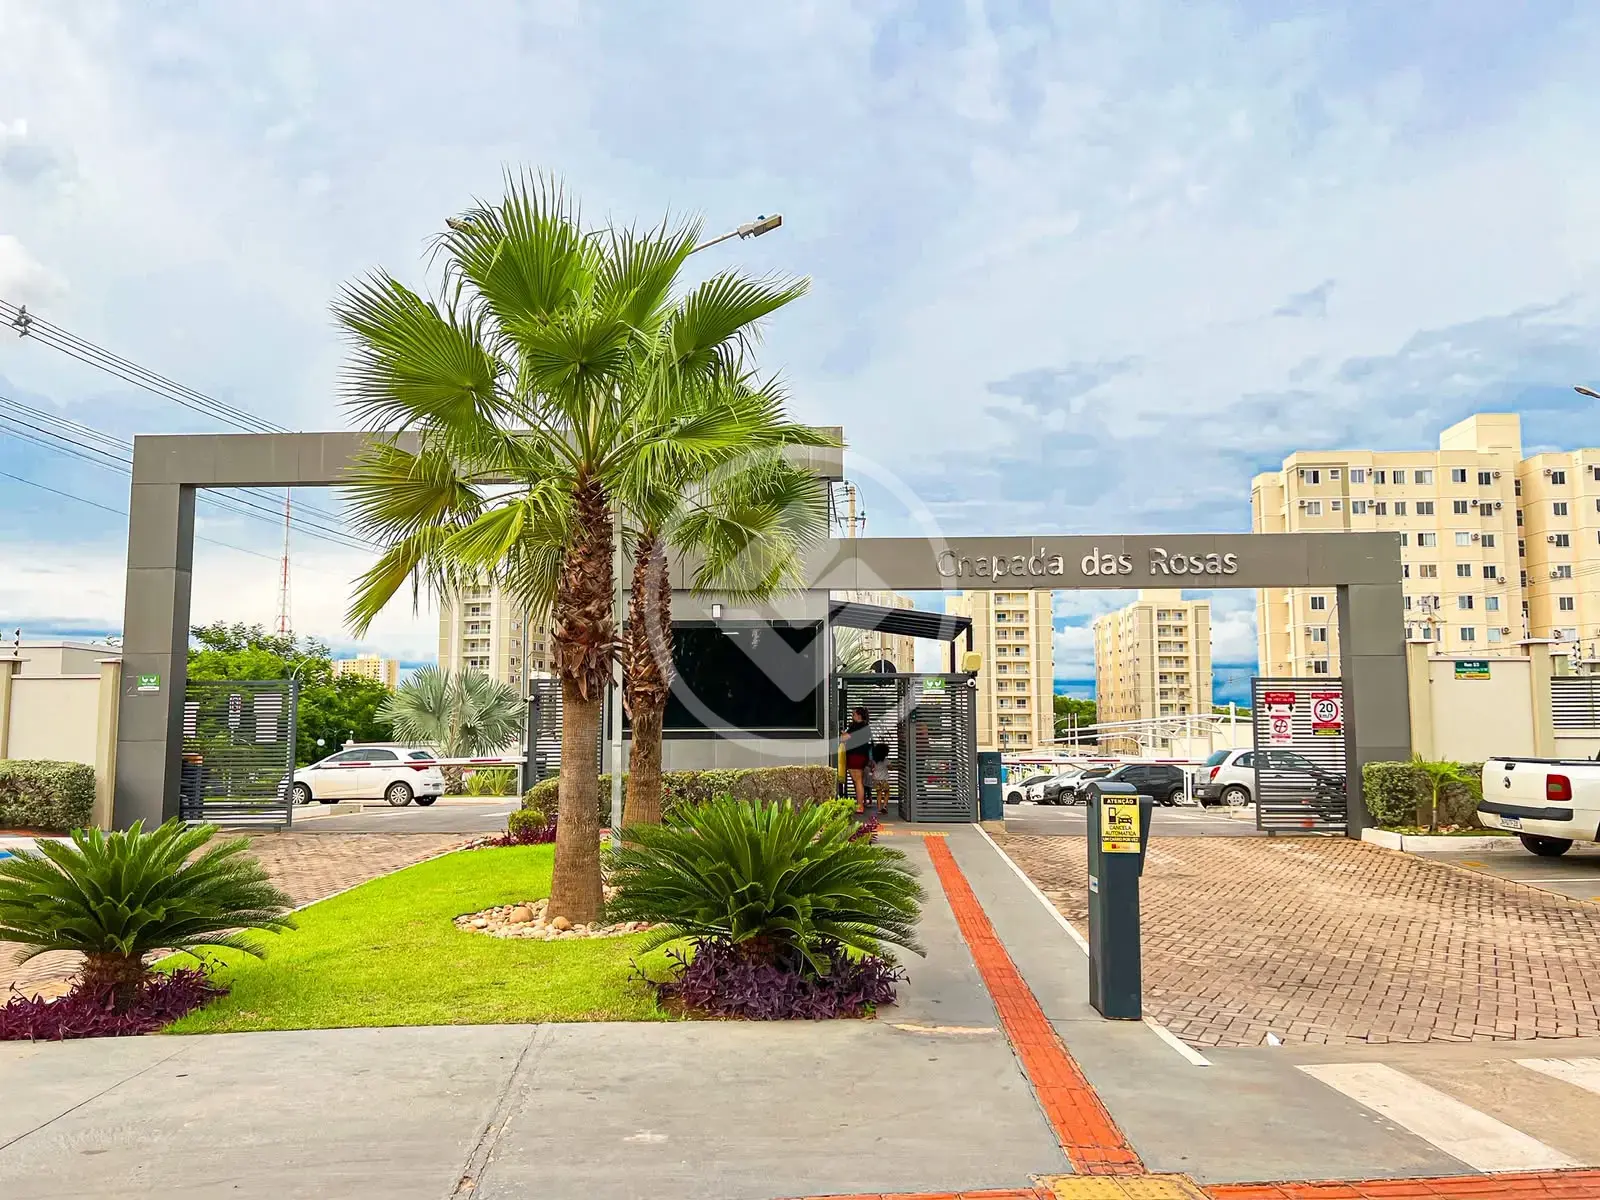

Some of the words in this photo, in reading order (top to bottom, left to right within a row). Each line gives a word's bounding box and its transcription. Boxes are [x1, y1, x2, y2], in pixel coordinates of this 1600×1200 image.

[1081, 547, 1132, 576] das
[1149, 547, 1239, 576] Rosas
[1319, 703, 1333, 713] 20
[1106, 797, 1134, 805] ATENÇÃO
